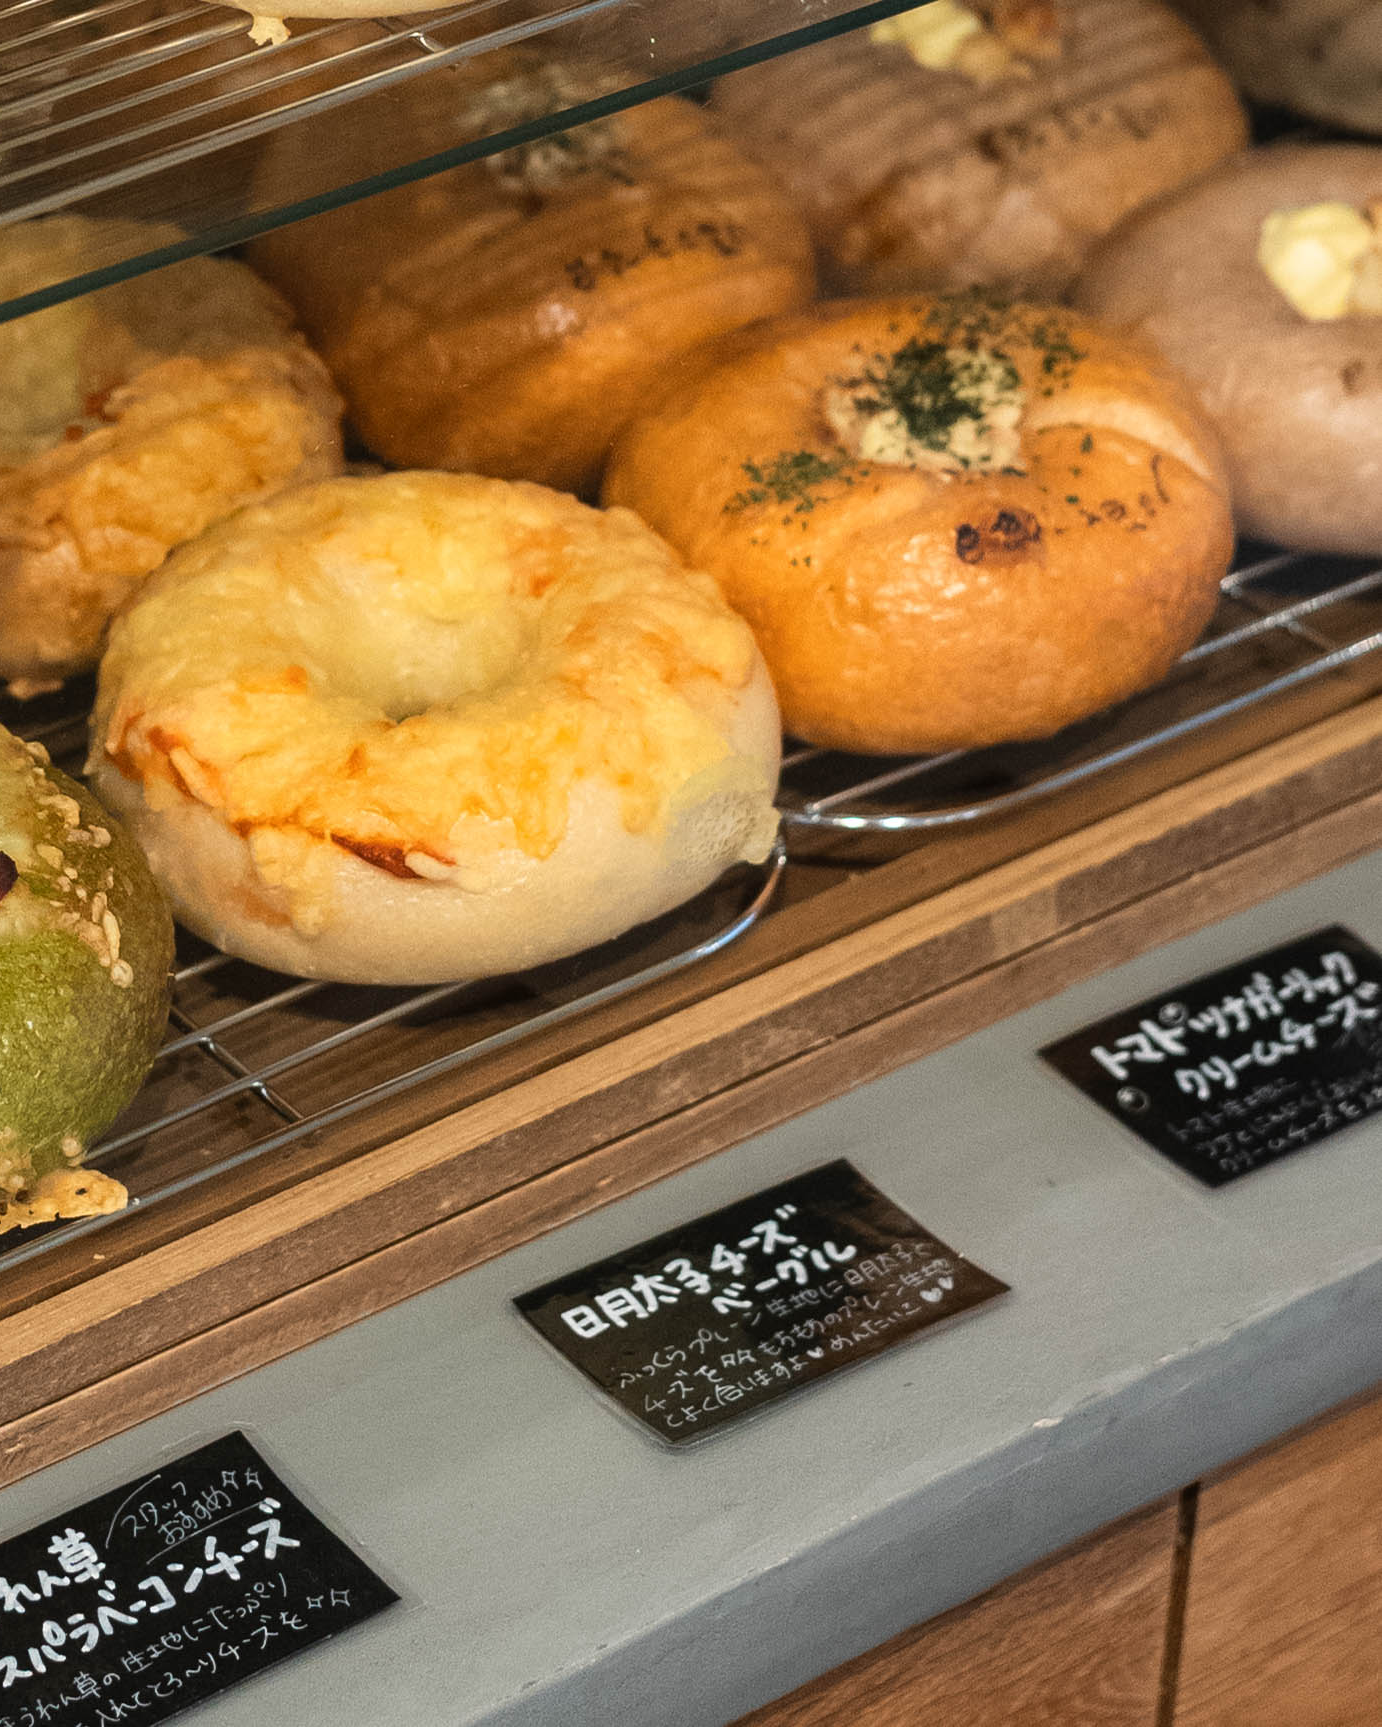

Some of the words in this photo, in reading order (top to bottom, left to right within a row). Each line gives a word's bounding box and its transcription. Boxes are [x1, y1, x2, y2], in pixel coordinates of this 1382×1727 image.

[1174, 980, 1381, 1101] クリームチーズ
[560, 1203, 800, 1340] 明太子チーズ
[711, 1240, 858, 1315] ベーグル
[120, 1481, 187, 1538] スタッフ
[157, 1486, 232, 1545] おすすめ
